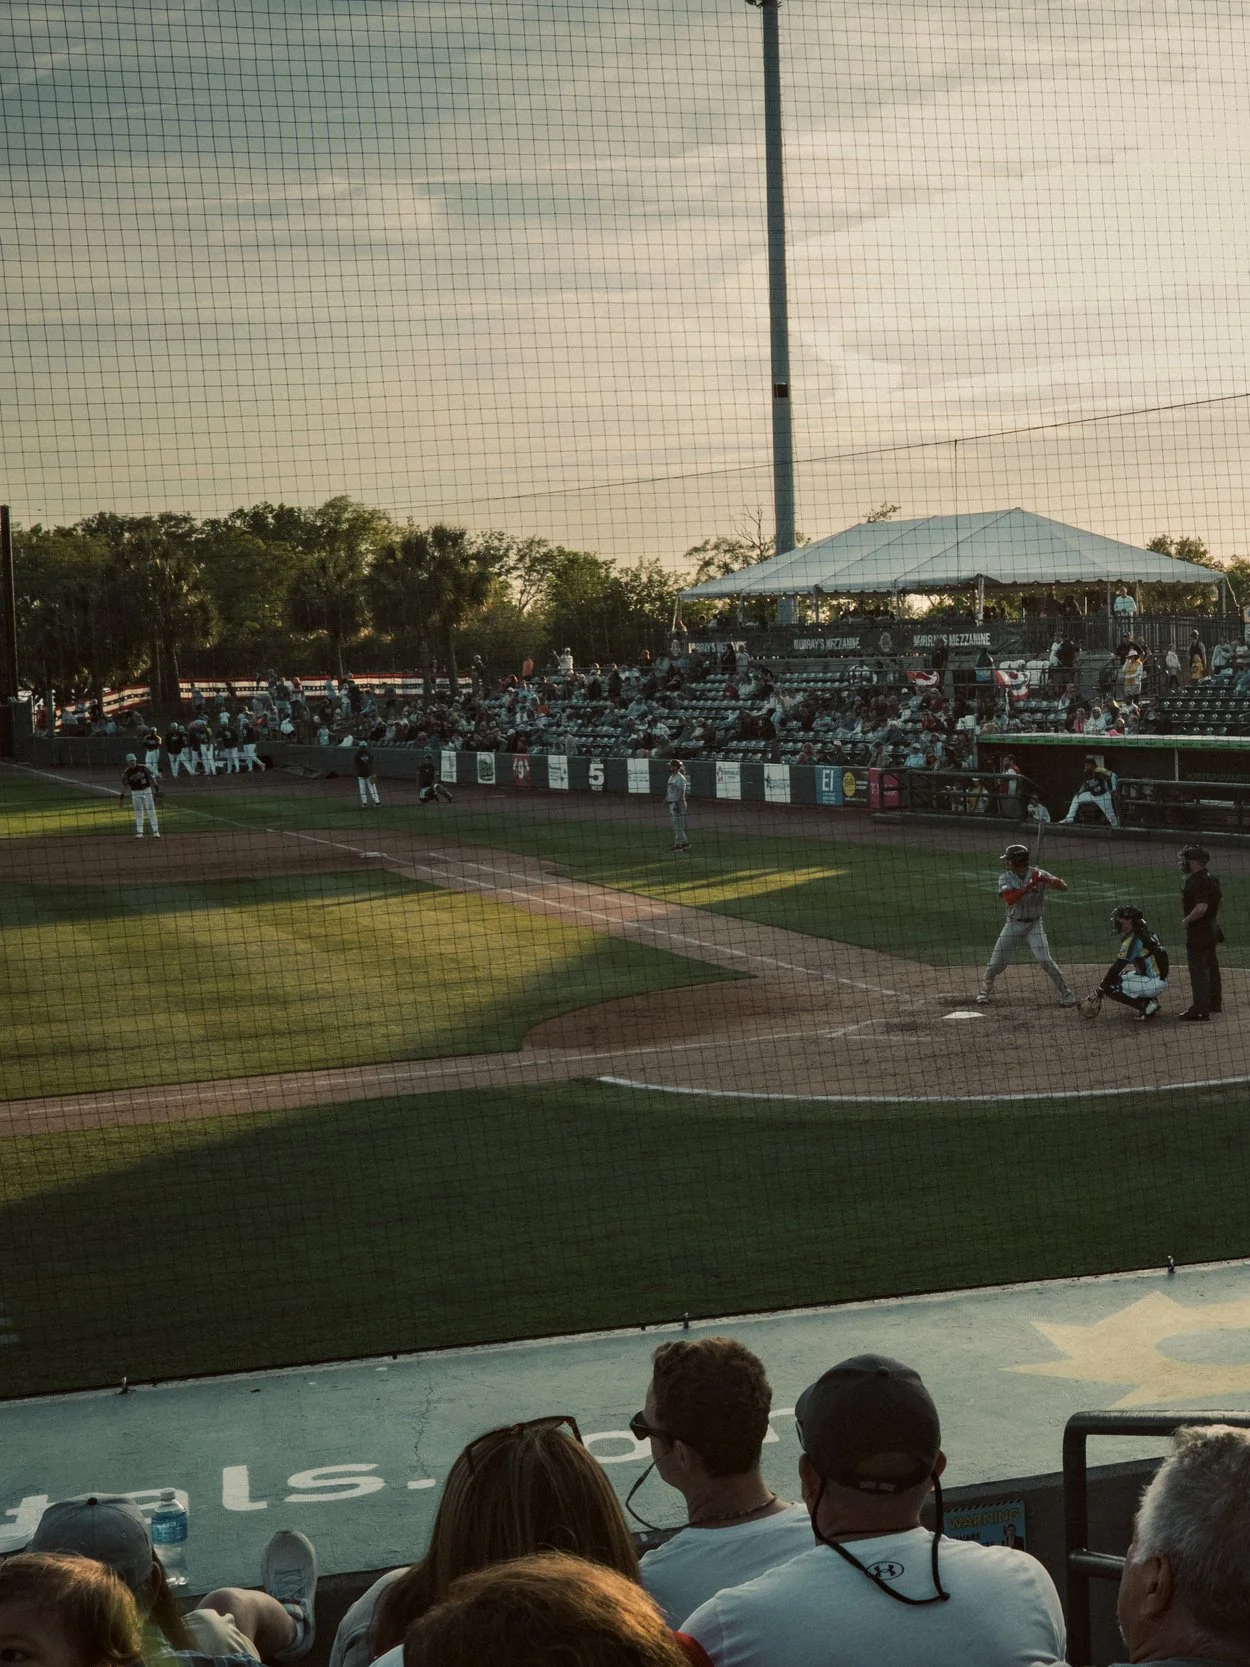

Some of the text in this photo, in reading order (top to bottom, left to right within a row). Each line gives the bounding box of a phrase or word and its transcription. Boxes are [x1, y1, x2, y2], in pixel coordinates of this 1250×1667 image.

[948, 632, 991, 646] MEZZANINE
[588, 763, 605, 786] 5
[950, 1507, 1020, 1529] WARNING
